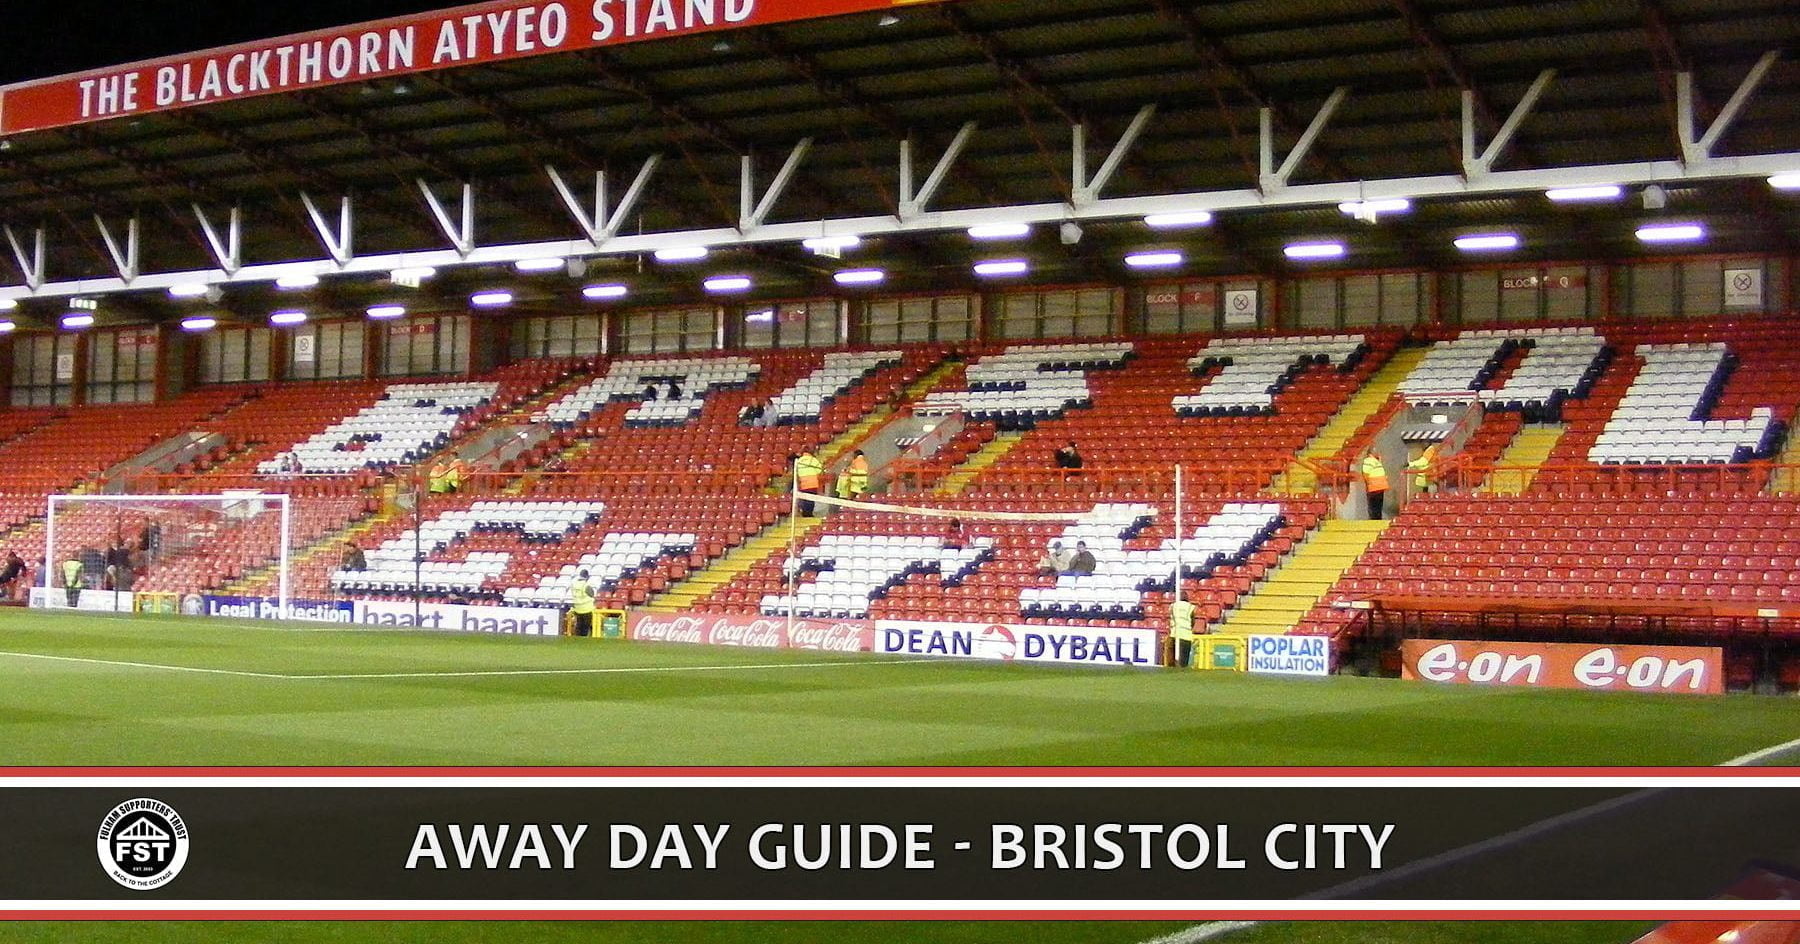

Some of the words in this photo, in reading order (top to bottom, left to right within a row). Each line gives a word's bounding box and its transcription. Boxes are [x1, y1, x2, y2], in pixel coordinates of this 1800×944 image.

[79, 72, 139, 117] THE
[155, 26, 414, 106] BLACKTHORN
[432, 2, 566, 63] ATYEO
[209, 600, 256, 618] Legal
[260, 602, 352, 623] Prtection
[363, 605, 443, 628] haart
[462, 609, 549, 635] haart
[884, 628, 972, 655] DEAN
[1024, 633, 1148, 663] DYBALL
[1251, 637, 1324, 657] POPLAR
[1250, 656, 1324, 672] INSULATION
